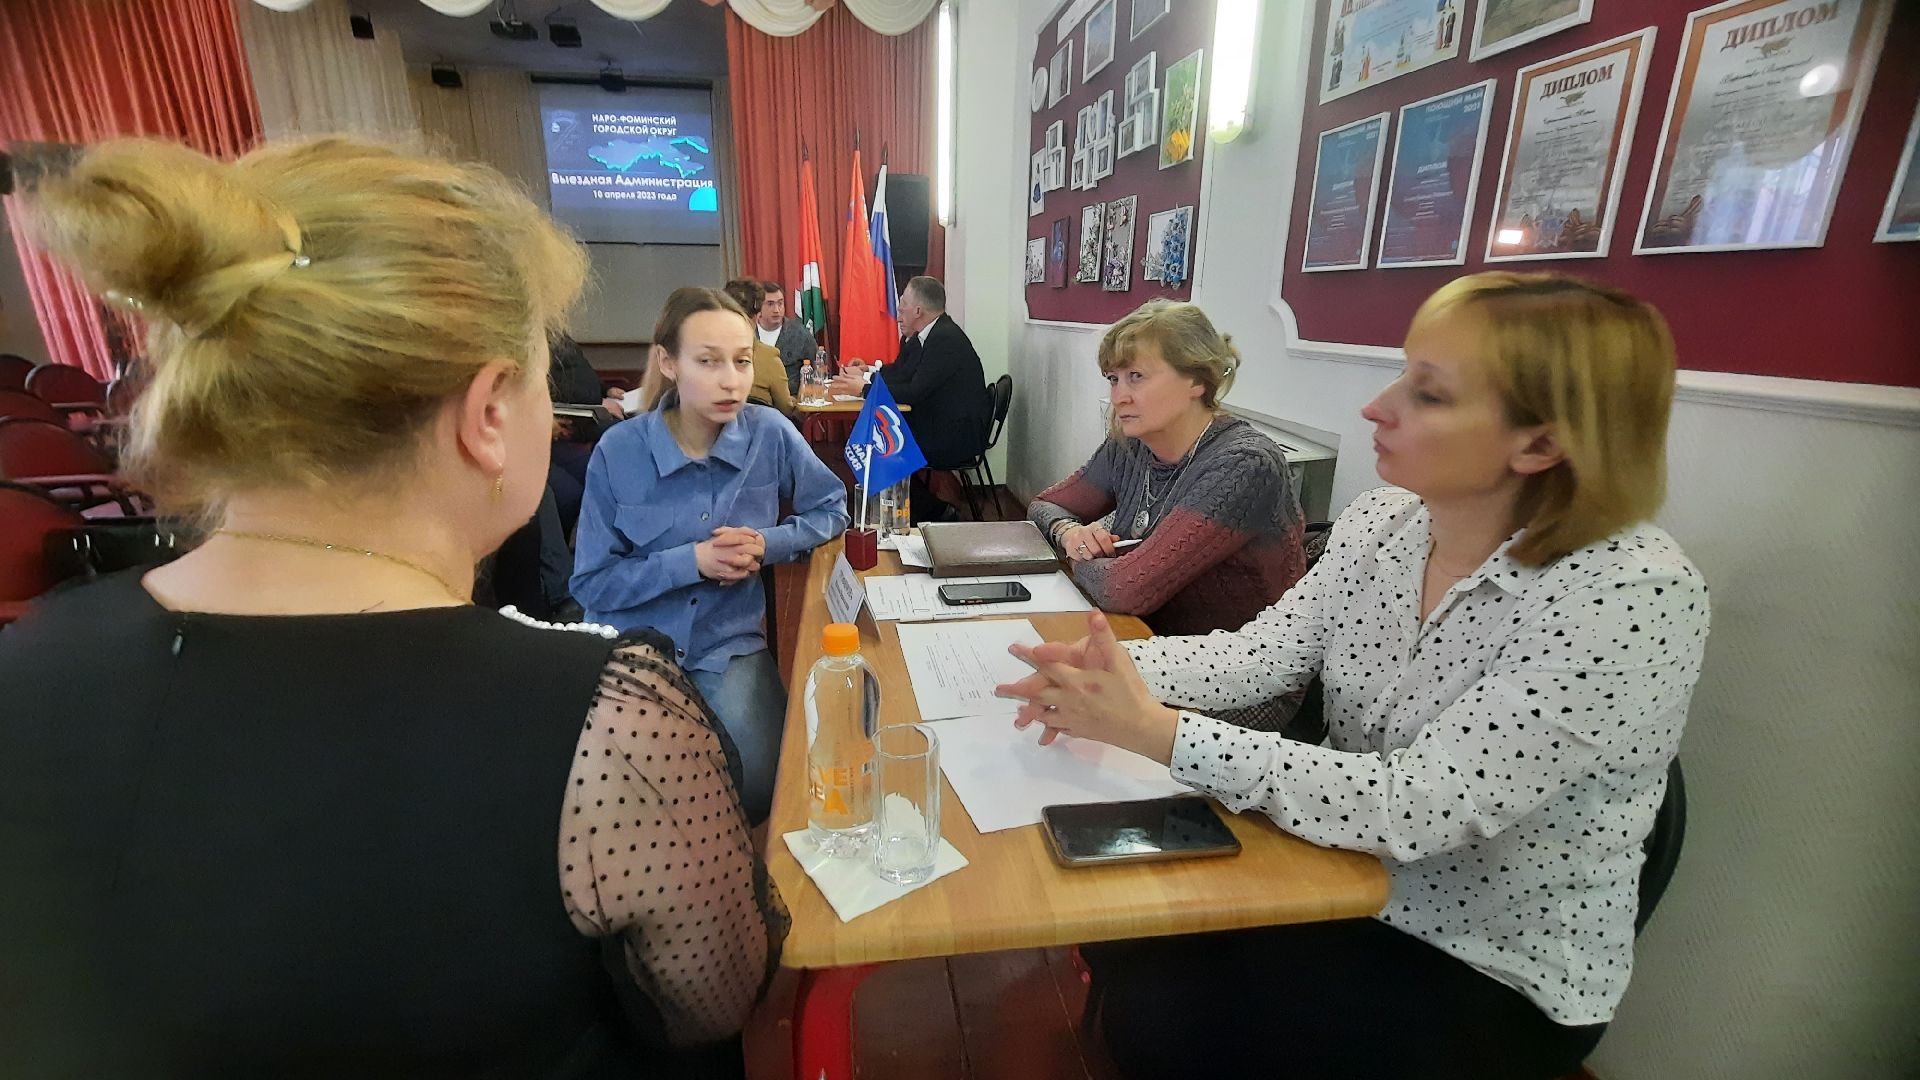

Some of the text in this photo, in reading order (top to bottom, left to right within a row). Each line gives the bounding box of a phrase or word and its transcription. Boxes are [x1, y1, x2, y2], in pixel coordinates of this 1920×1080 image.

[1720, 1, 1840, 53] ДИПЛОМ
[1540, 63, 1615, 101] ДИПЛОМ
[592, 114, 677, 125] НАРО-ФОМИНСКИЙ
[593, 124, 677, 136] ГОРОДСКОЙ ОКРУГ
[551, 172, 713, 189] Выездная Администрация
[604, 191, 635, 200] апреля
[636, 191, 657, 200] 2023
[657, 193, 677, 201] года
